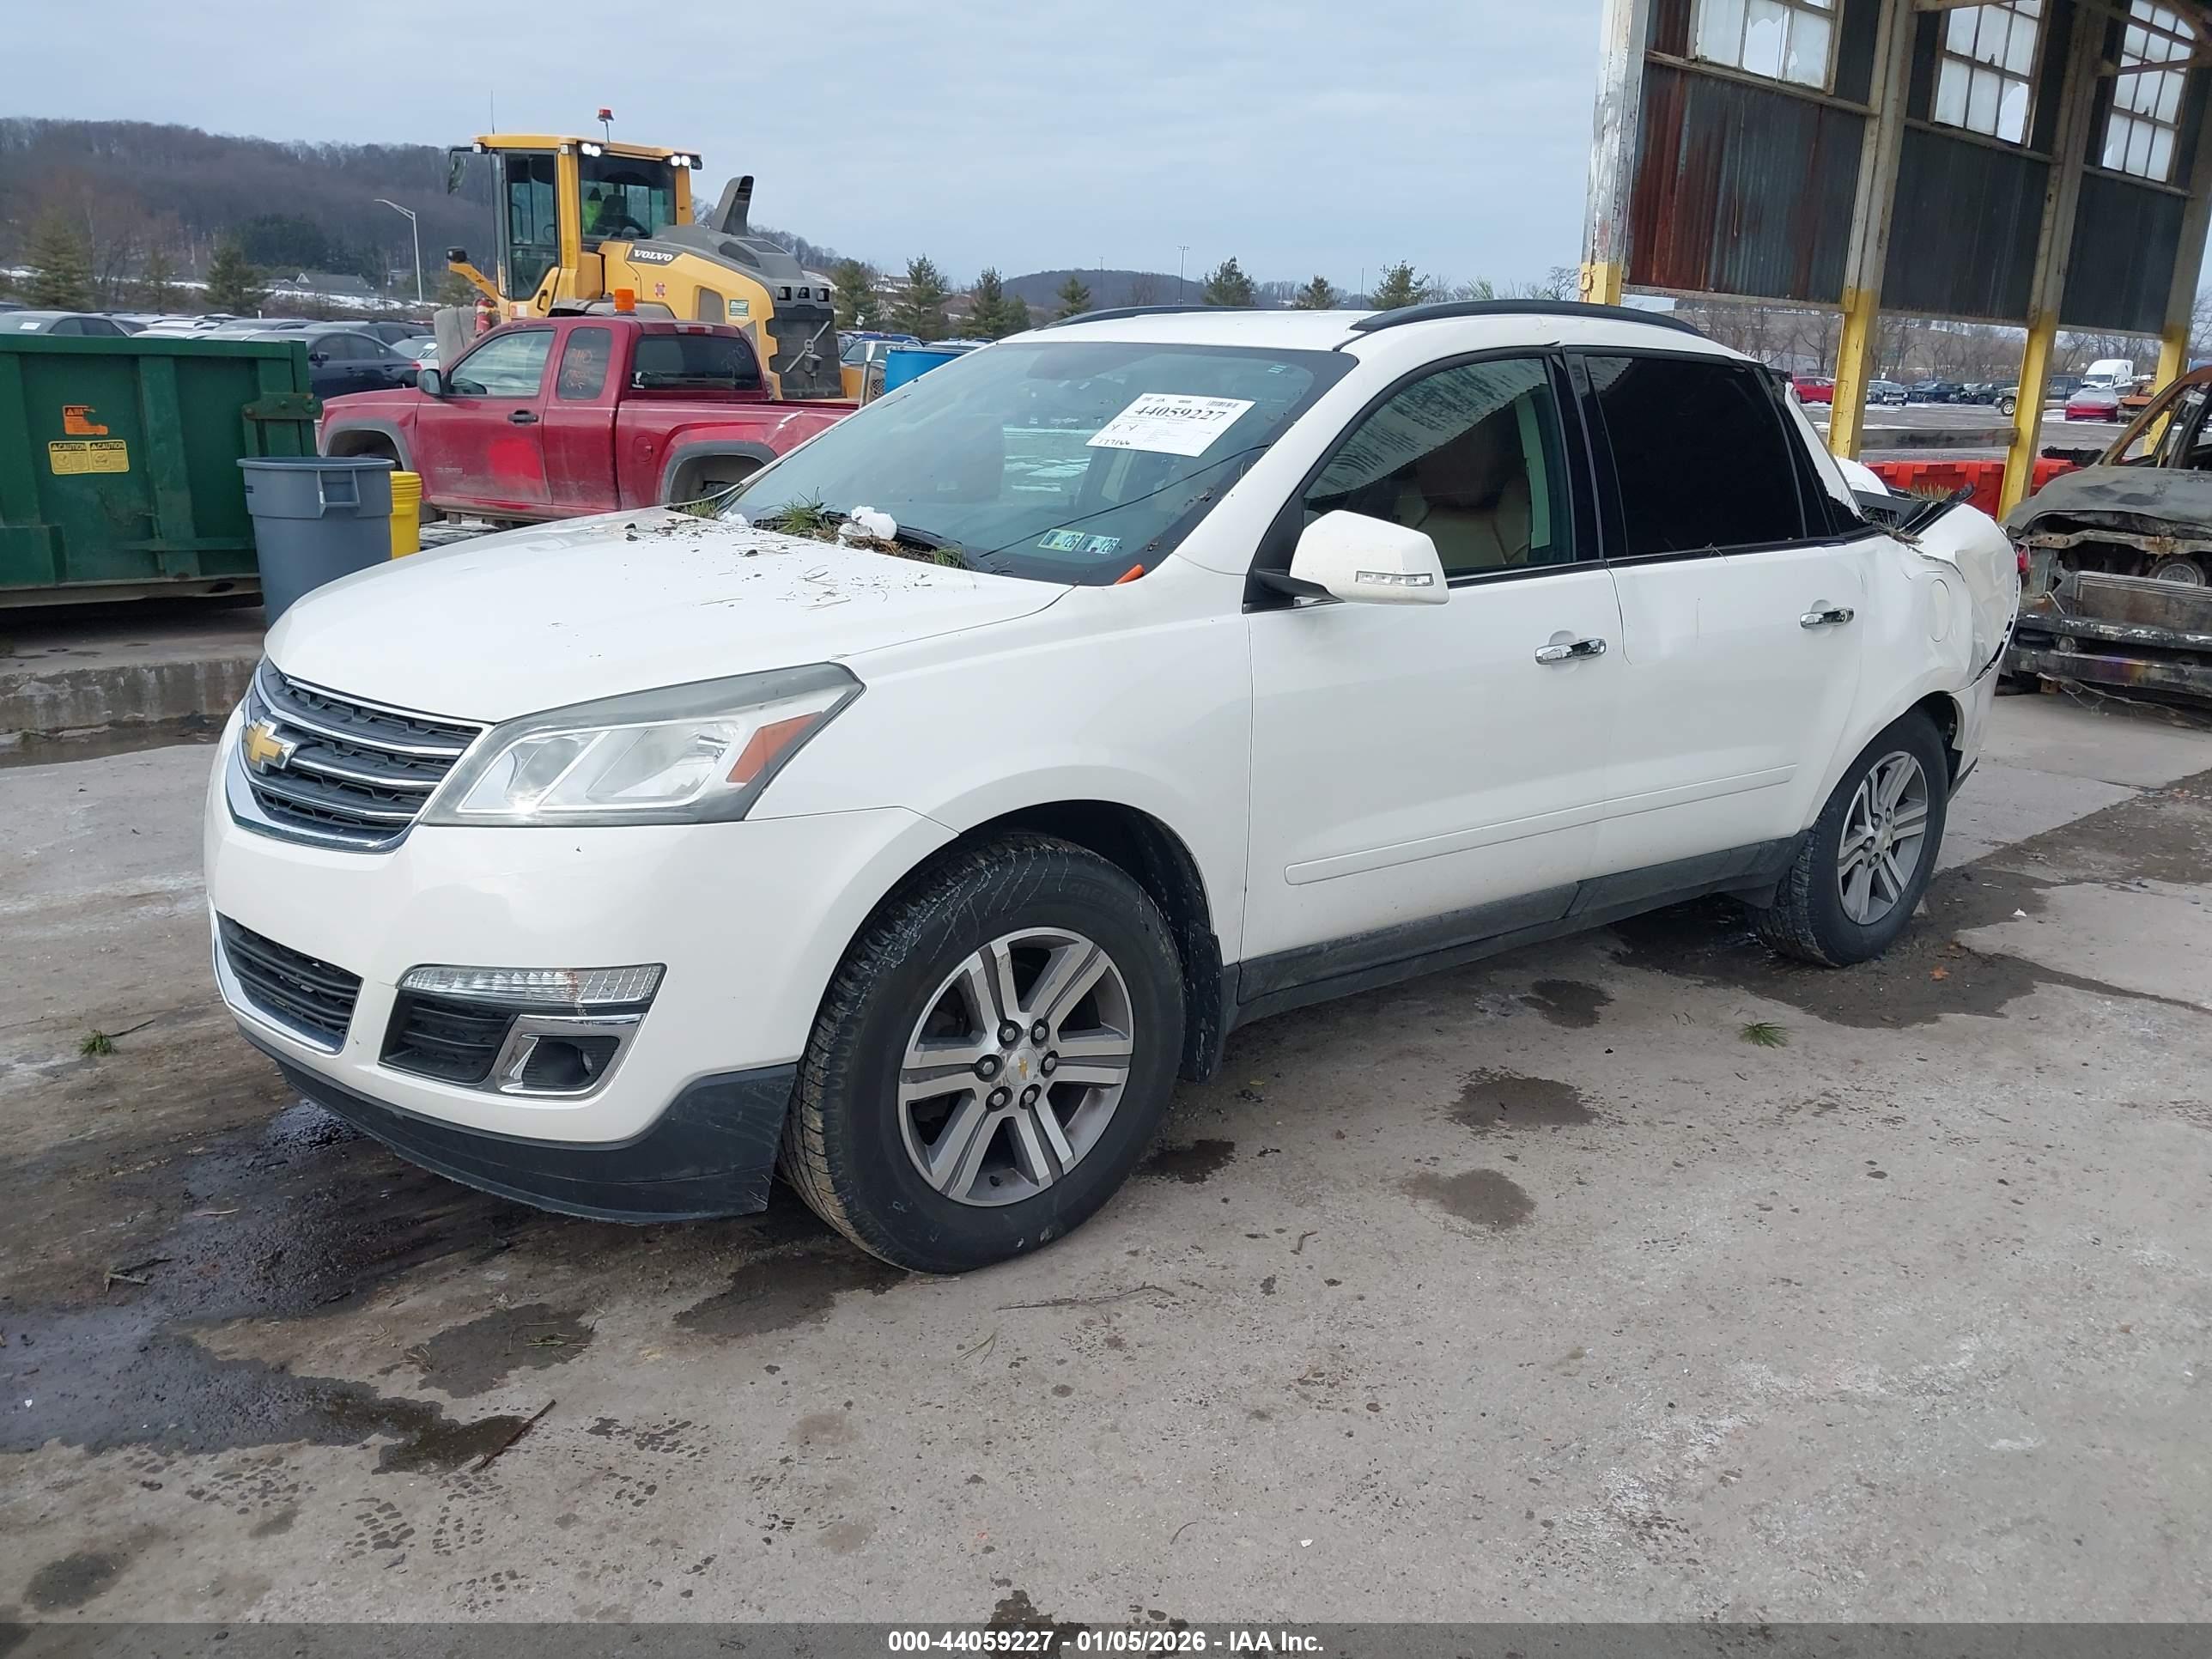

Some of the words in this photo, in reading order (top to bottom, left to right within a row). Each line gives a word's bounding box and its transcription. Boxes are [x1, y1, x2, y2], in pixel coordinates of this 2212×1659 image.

[634, 249, 674, 262] VOLVO
[1134, 405, 1227, 422] 44059227
[59, 442, 87, 451] CAUTION
[97, 441, 125, 450] CAUTION
